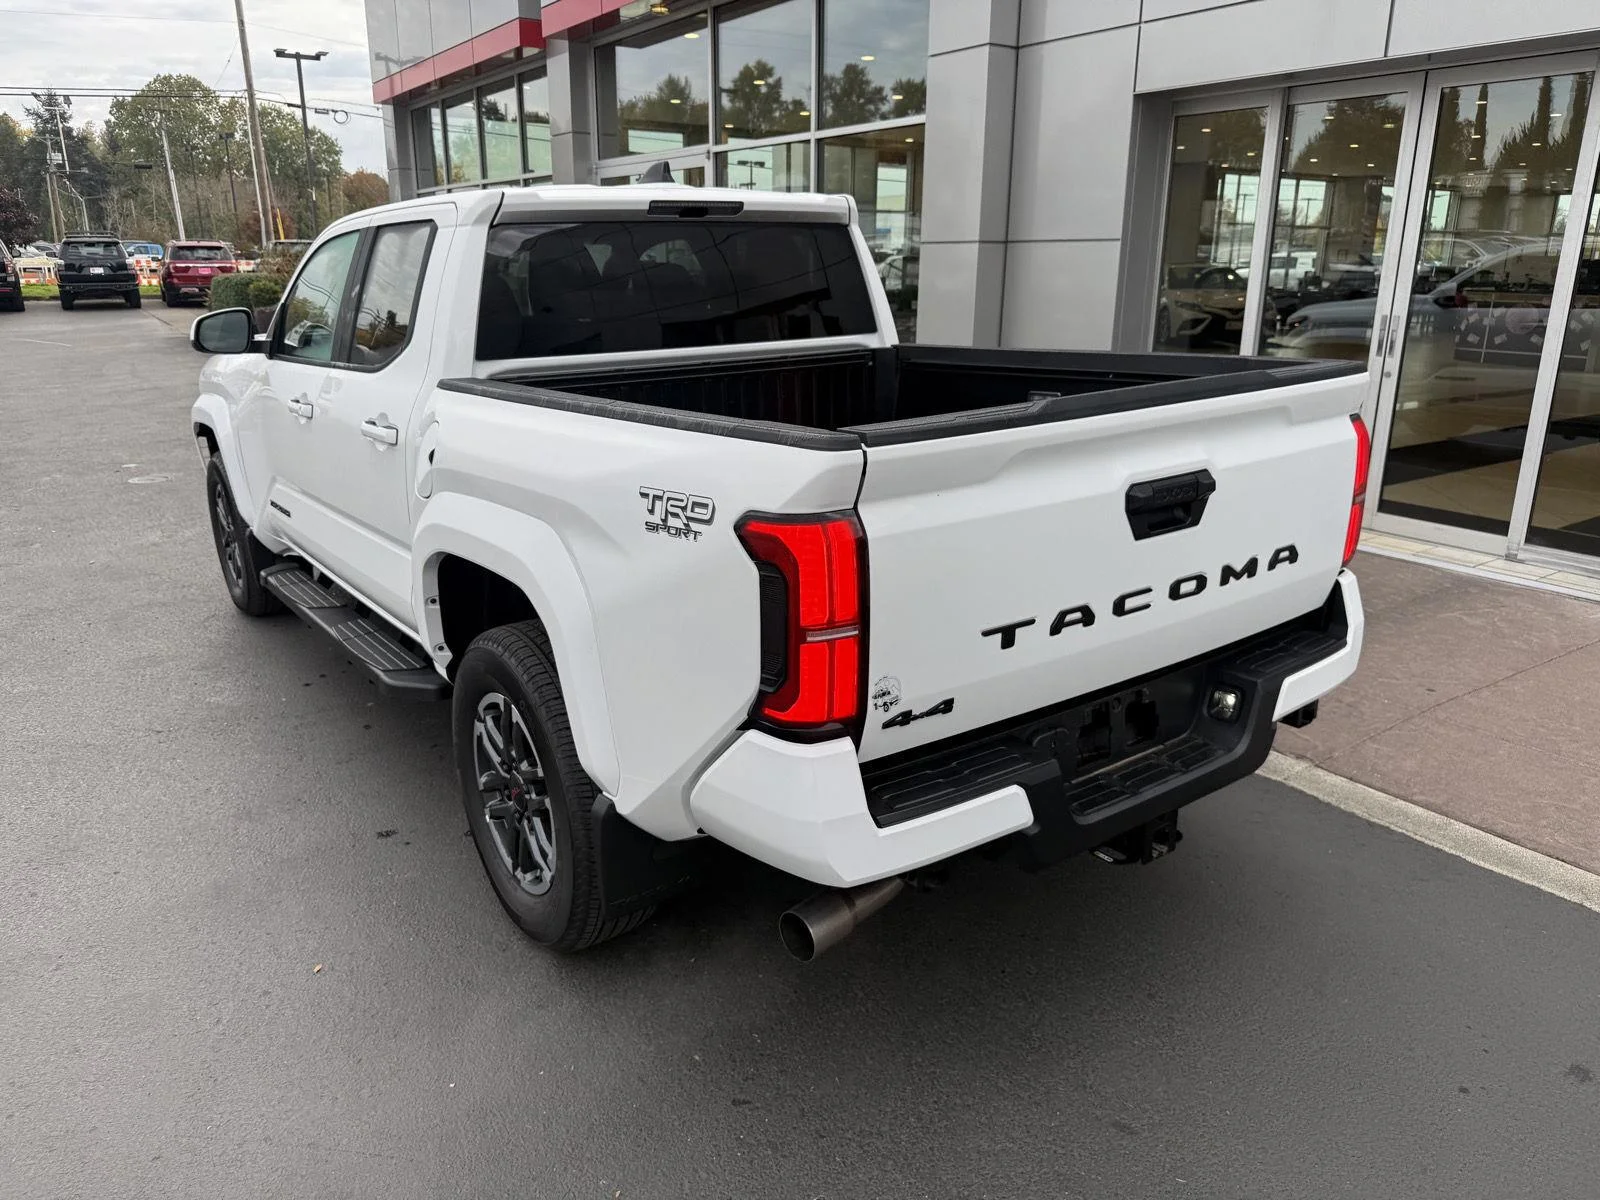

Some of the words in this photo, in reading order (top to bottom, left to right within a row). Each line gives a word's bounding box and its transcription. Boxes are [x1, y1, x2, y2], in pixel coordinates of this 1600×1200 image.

[639, 485, 716, 530] TRD
[645, 521, 703, 542] SPORT
[980, 543, 1299, 649] TACOMA
